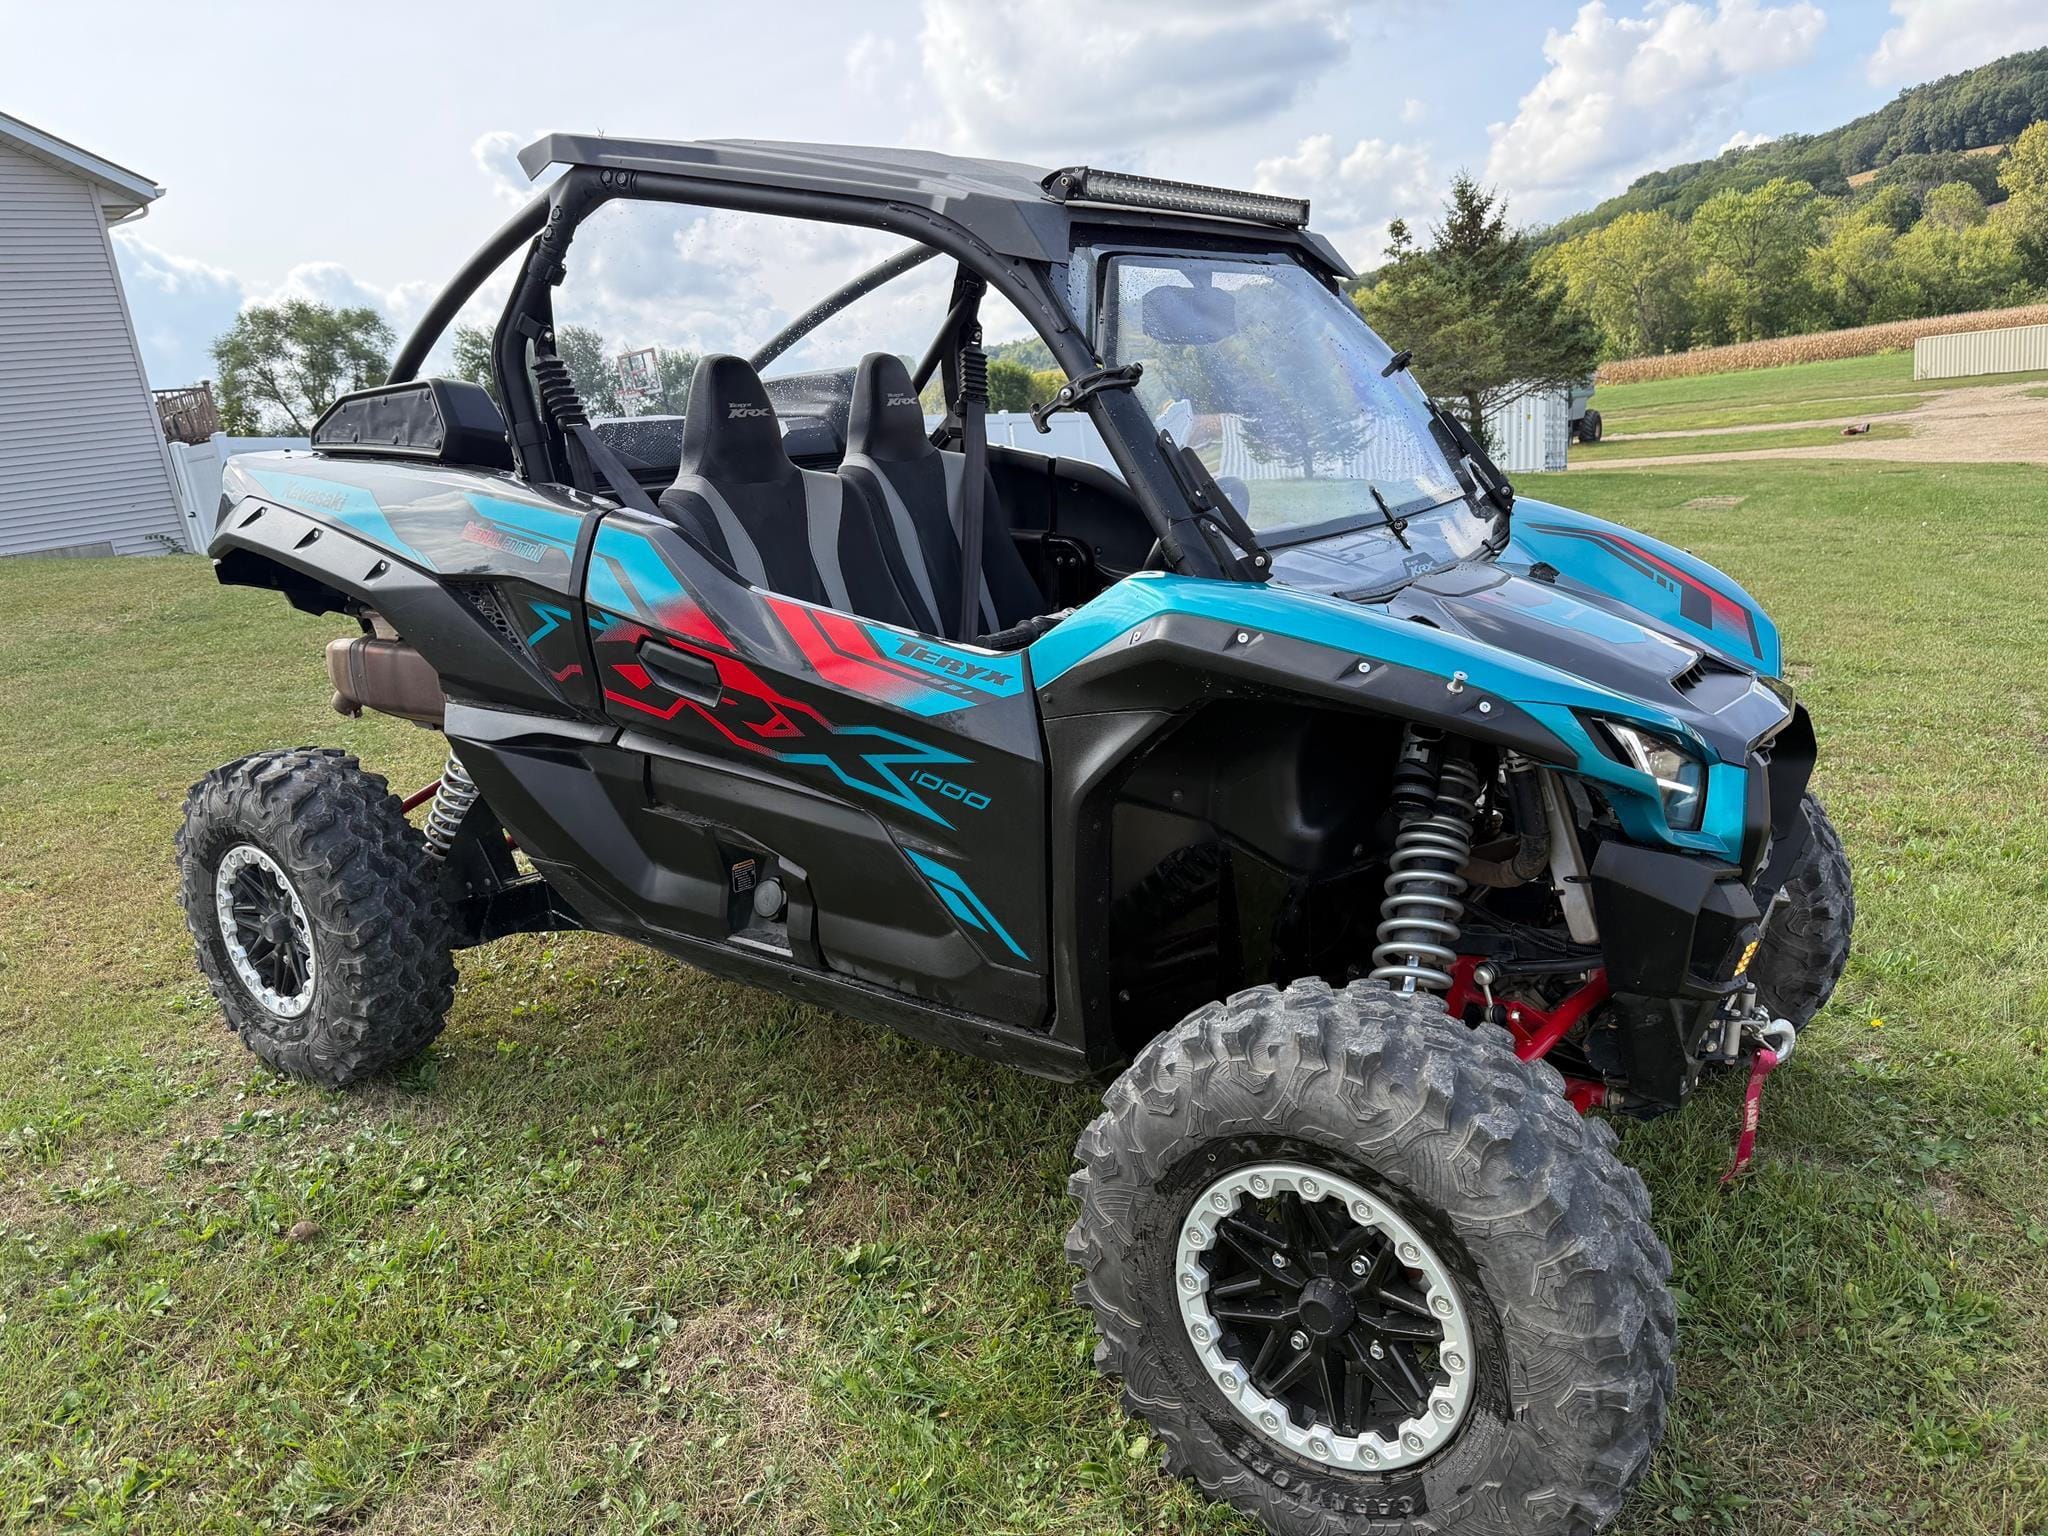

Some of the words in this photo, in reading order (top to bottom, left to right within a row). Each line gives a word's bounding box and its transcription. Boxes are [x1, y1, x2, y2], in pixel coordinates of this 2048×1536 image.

[727, 408, 771, 419] KRX
[280, 480, 349, 512] Kawasaki
[500, 535, 548, 563] EDITION
[908, 769, 992, 811] 1000
[1745, 1096, 1758, 1133] WARN
